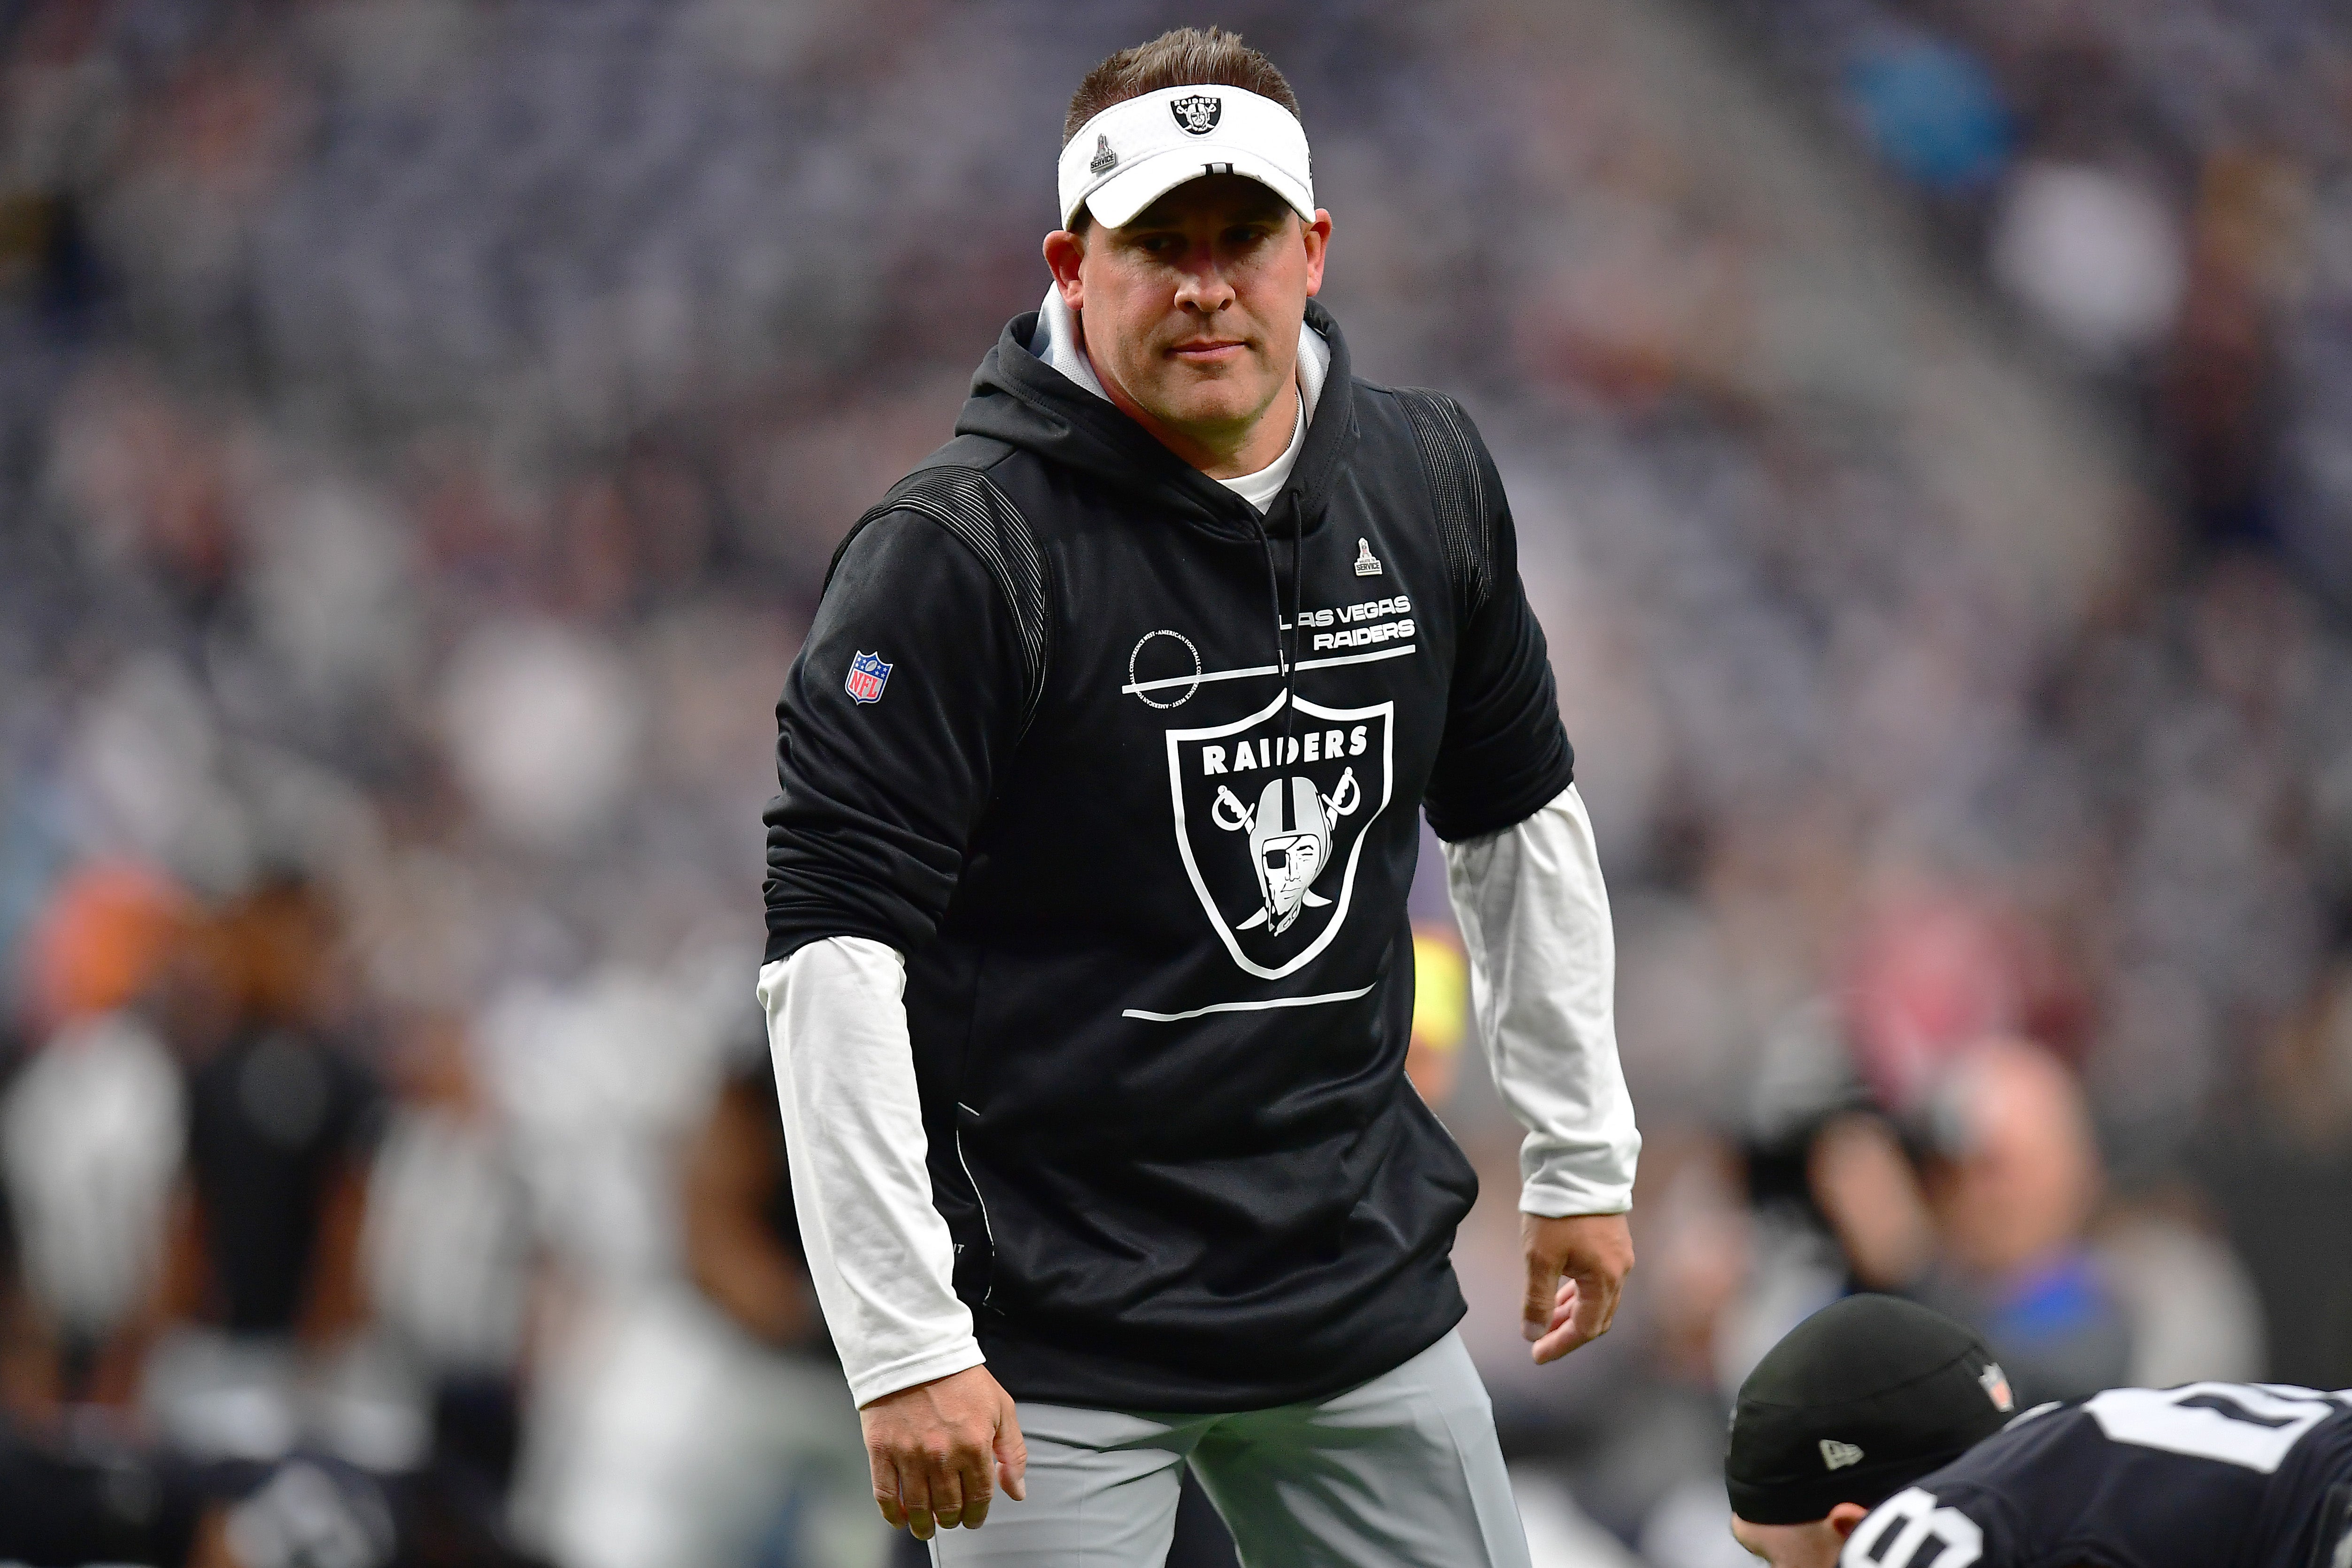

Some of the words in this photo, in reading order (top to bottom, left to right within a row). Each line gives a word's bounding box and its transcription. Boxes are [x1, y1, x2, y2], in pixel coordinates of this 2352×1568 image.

[1174, 98, 1217, 106] RAIDERS
[1091, 154, 1114, 169] SERVICE
[1356, 562, 1380, 571] SERVICE
[1279, 609, 1334, 630] LAS
[1336, 595, 1411, 623] VEGAS
[1143, 631, 1155, 641] WEST
[1157, 630, 1186, 642] AMERICAN
[1314, 619, 1415, 651] RAIDERS
[1129, 638, 1145, 673] CONFERENCE
[1184, 638, 1201, 666] FOOTBALL
[849, 670, 878, 698] NFL
[1129, 672, 1144, 699] FOOALL
[1142, 697, 1169, 709] AMERICAN
[1172, 697, 1187, 708] WEST
[1203, 725, 1368, 776] RAIDERS
